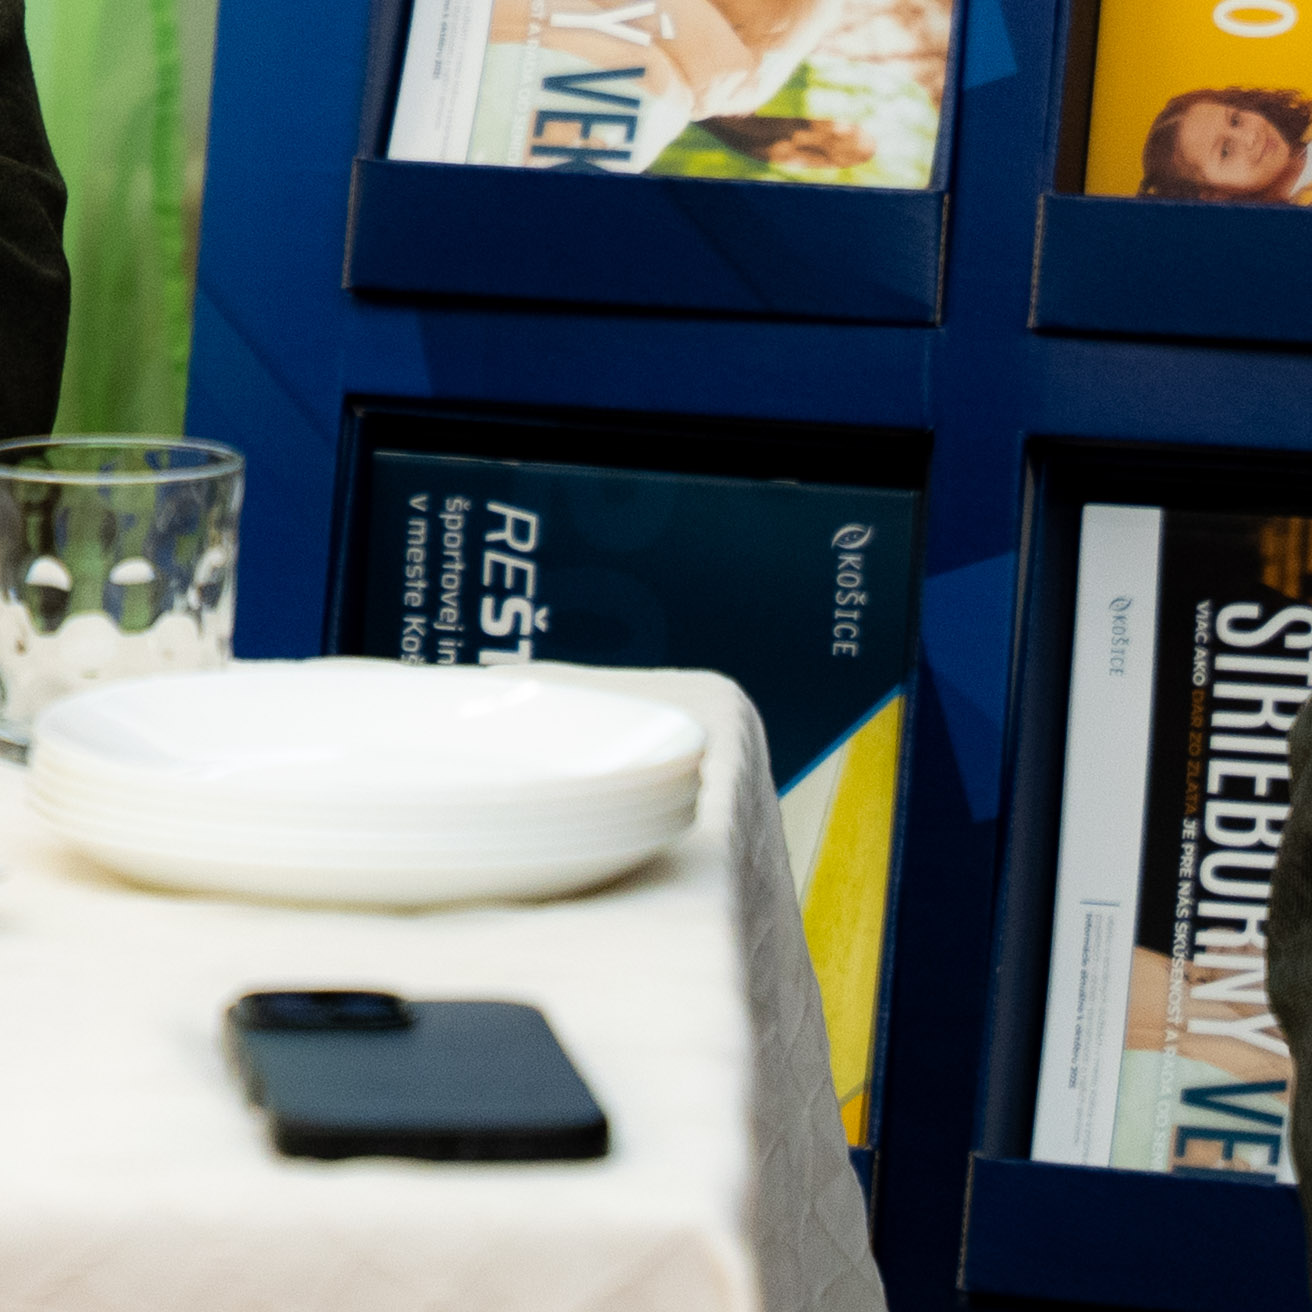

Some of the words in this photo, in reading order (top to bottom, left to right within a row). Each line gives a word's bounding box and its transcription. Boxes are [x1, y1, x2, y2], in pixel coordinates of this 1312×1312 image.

[409, 493, 430, 513] v
[404, 519, 429, 608] meste
[433, 495, 473, 632] športovej
[832, 553, 867, 657] KOŠICE
[1194, 599, 1212, 644] VIAC
[1109, 614, 1130, 677] KOŠICE
[1192, 646, 1208, 687] AKO
[1190, 689, 1206, 728] DAR
[1188, 731, 1203, 756] ZO
[1183, 760, 1200, 815] ZLATA
[1182, 818, 1198, 840] JE
[1179, 841, 1195, 879] PRE
[1175, 881, 1192, 919] NÁS
[1164, 1029, 1179, 1042] A
